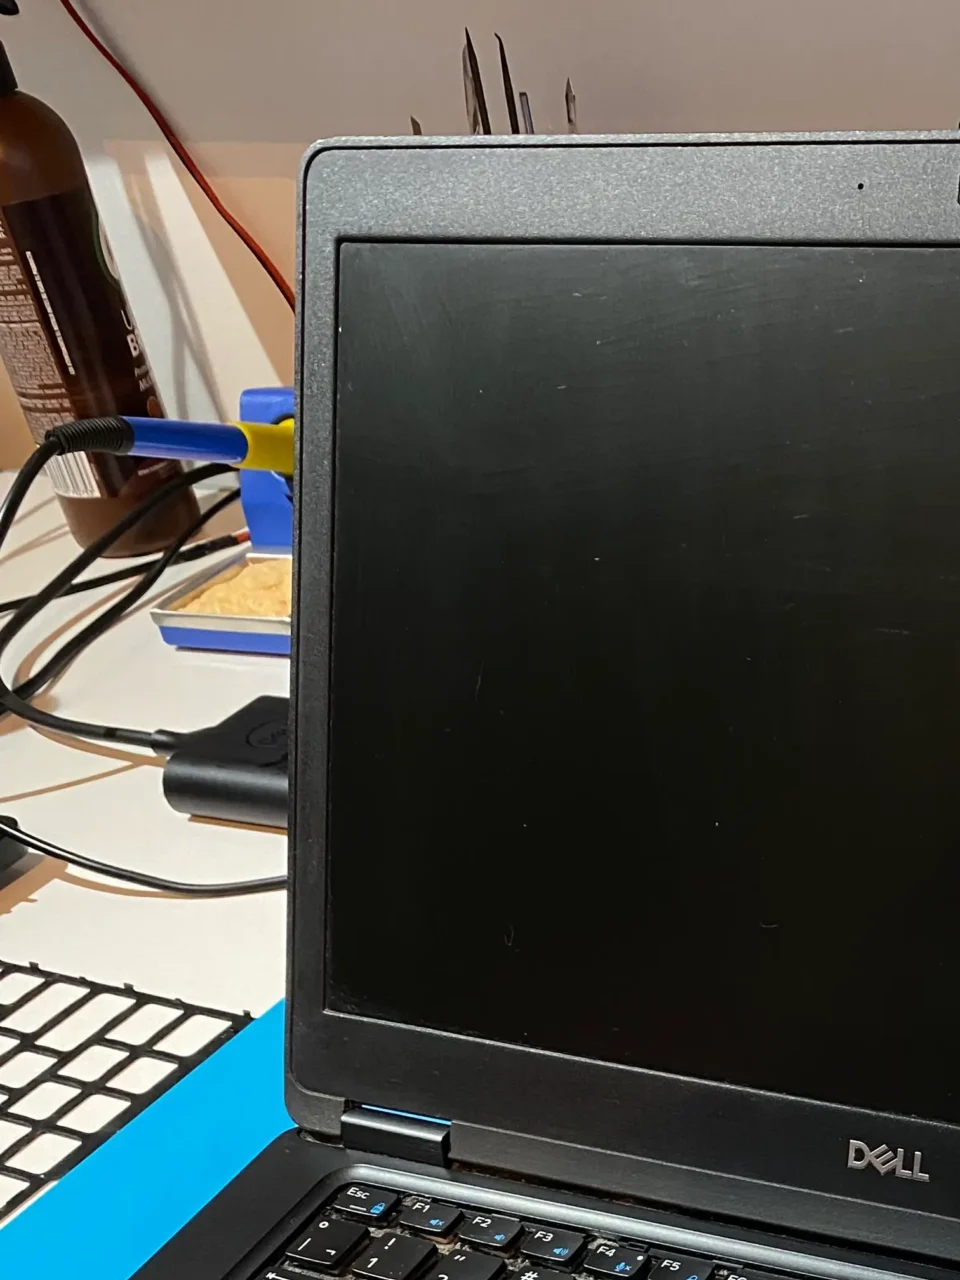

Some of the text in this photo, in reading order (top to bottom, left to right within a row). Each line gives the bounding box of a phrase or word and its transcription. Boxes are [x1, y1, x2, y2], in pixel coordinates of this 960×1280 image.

[847, 1139, 930, 1183] DELL
[346, 1186, 370, 1200] Esc
[412, 1202, 431, 1213] F1
[472, 1216, 492, 1228] F2
[531, 1228, 554, 1242] F3
[384, 1237, 397, 1250] !
[596, 1244, 616, 1259] F4
[367, 1257, 379, 1269] 1
[660, 1259, 682, 1271] F5
